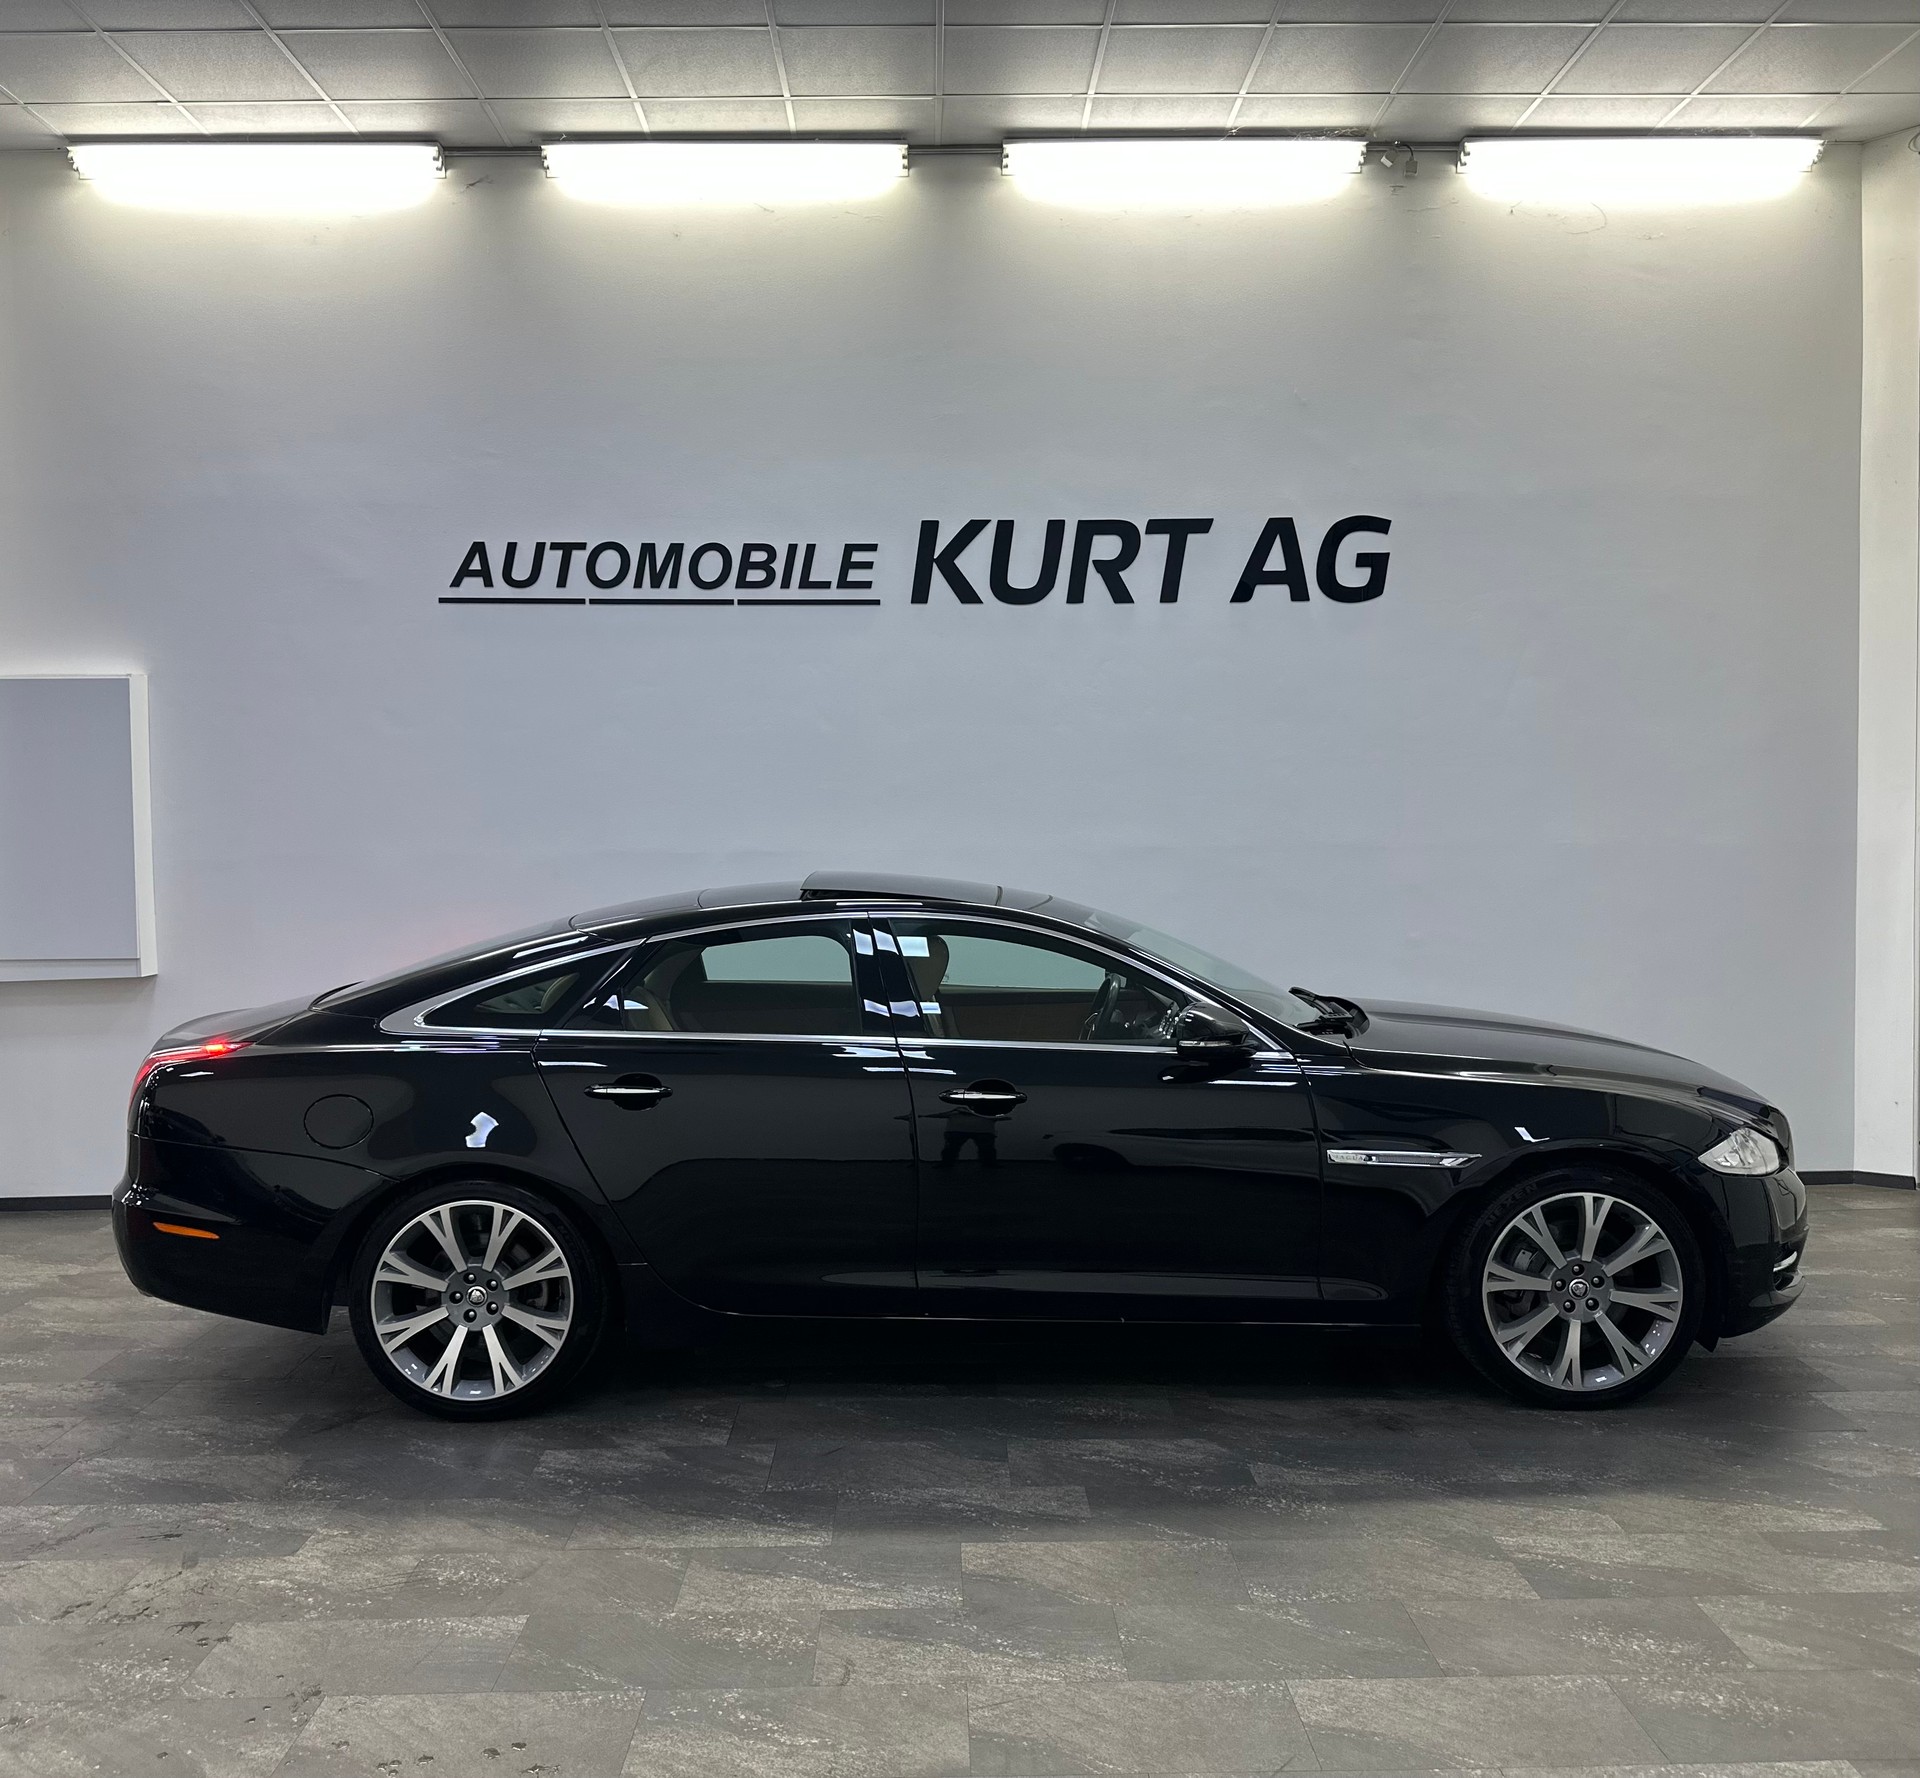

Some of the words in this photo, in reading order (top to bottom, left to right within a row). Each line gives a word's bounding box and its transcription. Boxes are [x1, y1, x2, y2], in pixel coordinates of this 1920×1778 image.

[450, 541, 879, 590] AUTOMOBILE
[911, 517, 1214, 605] KURT
[1230, 515, 1391, 604] AG
[1485, 1183, 1537, 1227] NEXEN
